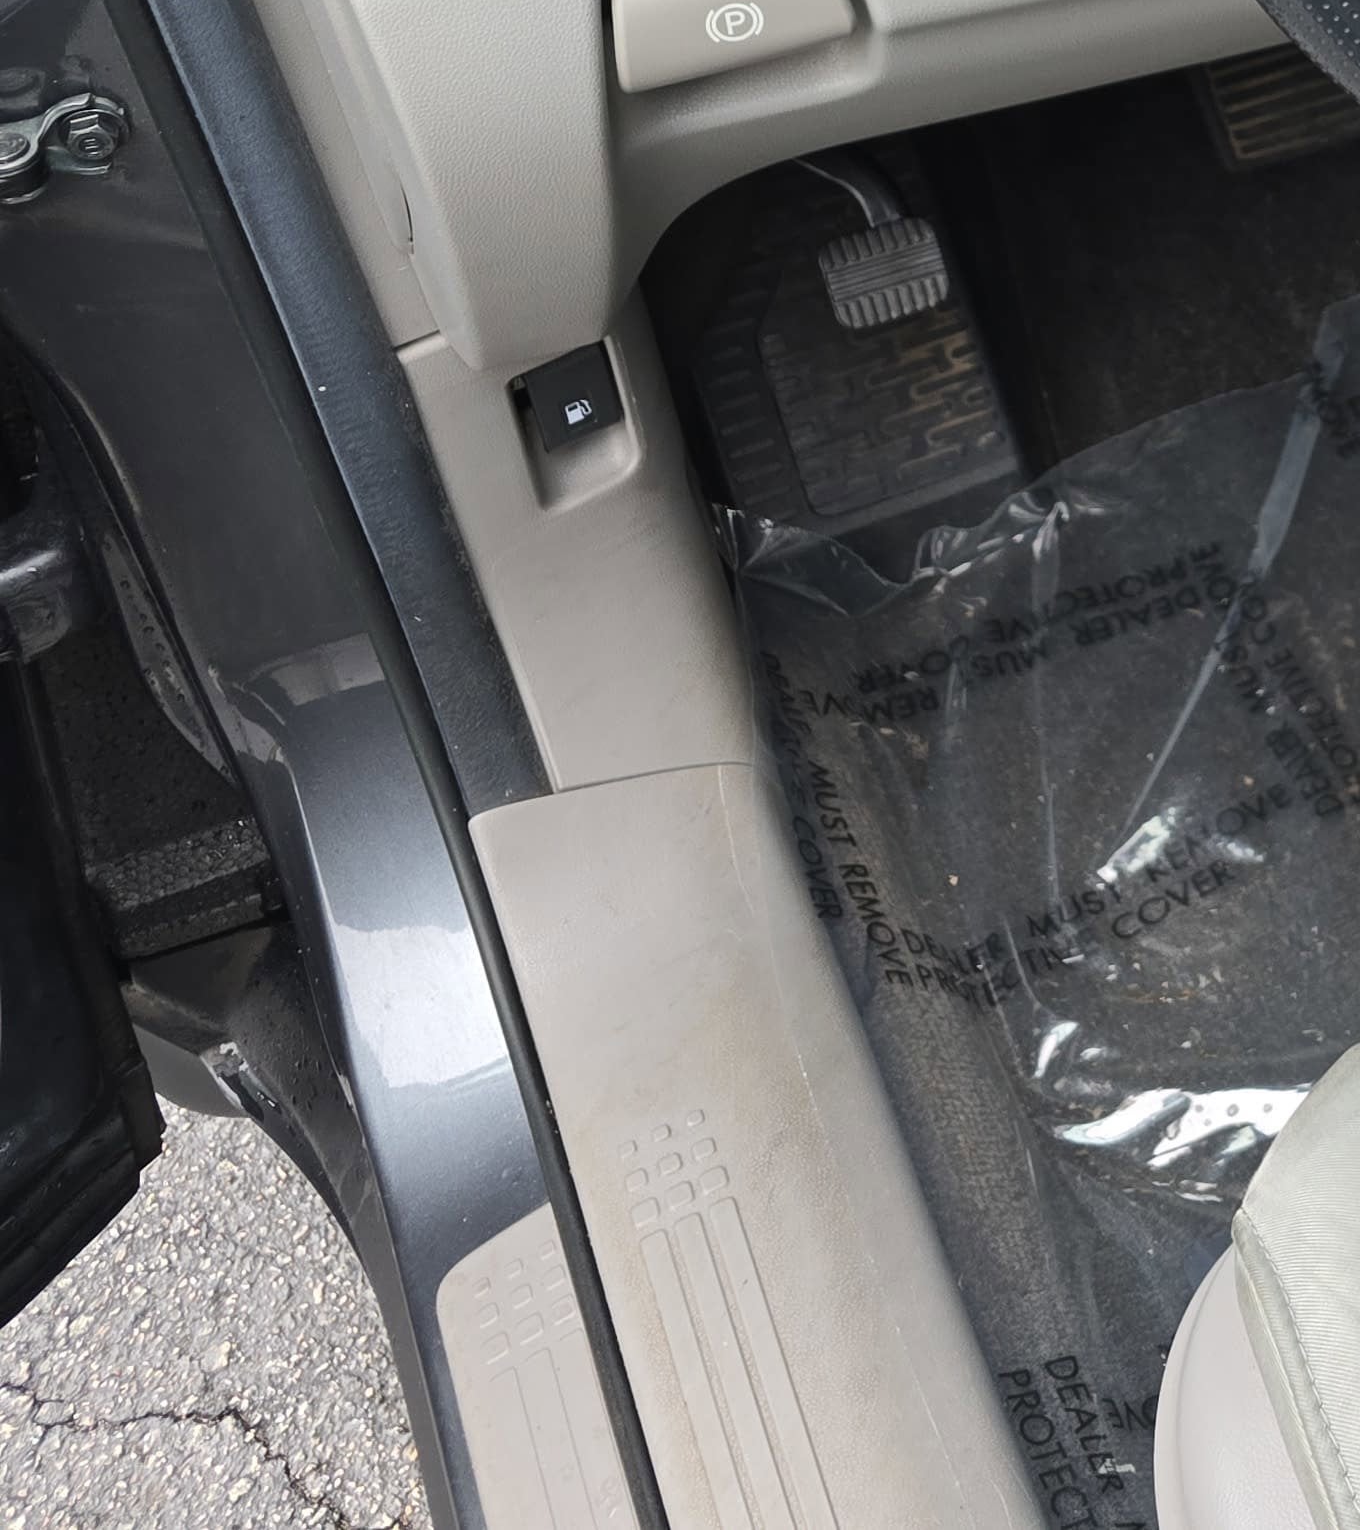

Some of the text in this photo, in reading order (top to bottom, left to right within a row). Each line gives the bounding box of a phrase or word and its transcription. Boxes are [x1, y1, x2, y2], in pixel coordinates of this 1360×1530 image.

[1070, 584, 1200, 648] DEALER
[791, 814, 844, 920] COVER
[806, 758, 858, 848] MUST
[837, 862, 914, 988] REMOVE
[1110, 857, 1240, 942] COVER
